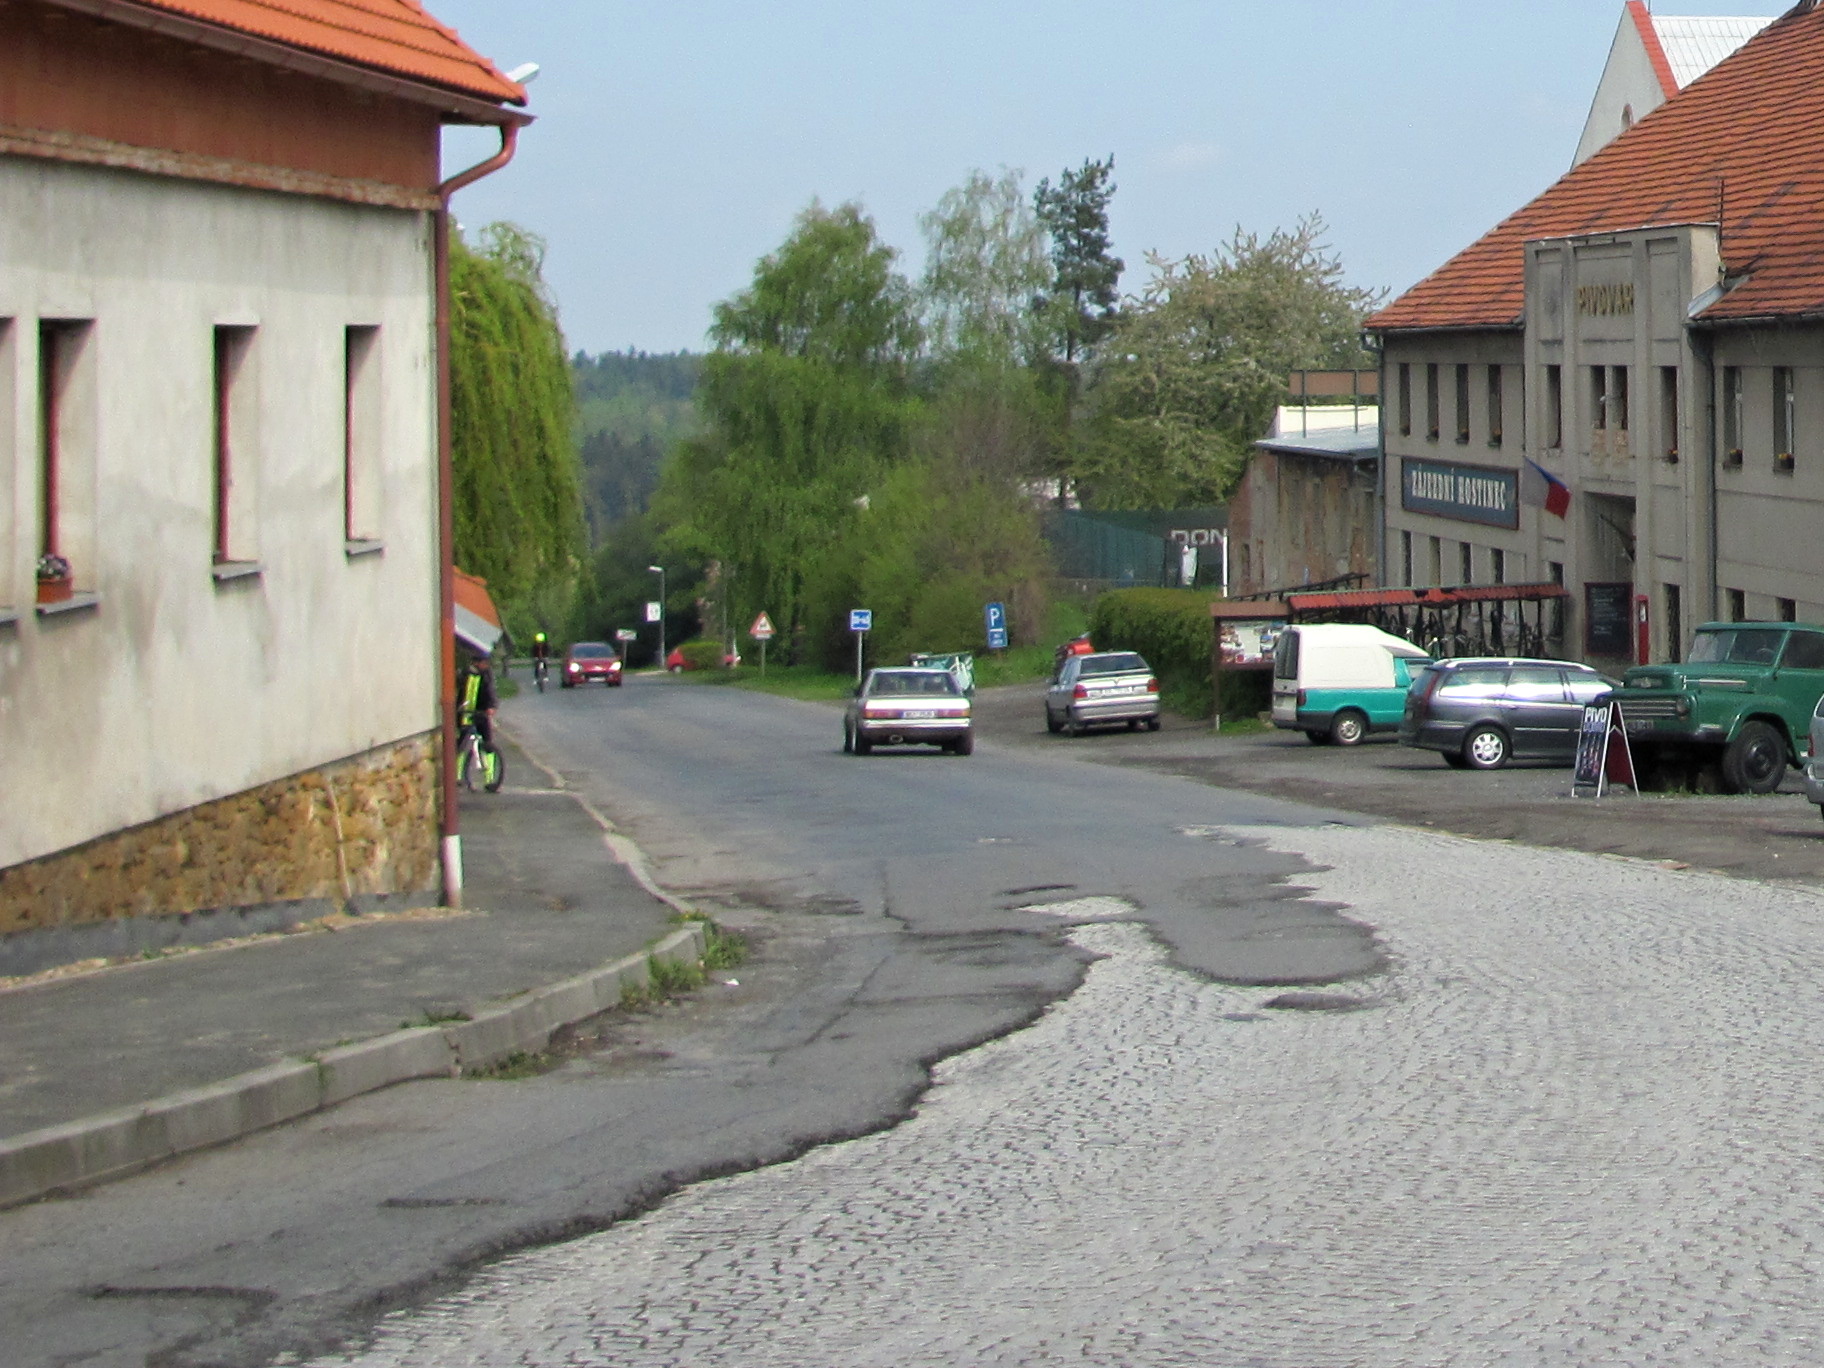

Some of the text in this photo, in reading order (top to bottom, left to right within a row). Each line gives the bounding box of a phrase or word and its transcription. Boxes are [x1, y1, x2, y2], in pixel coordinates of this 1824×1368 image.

[1458, 475, 1506, 511] HOSTINEC
[990, 607, 1000, 627] P
[1584, 706, 1608, 723] PIVO
